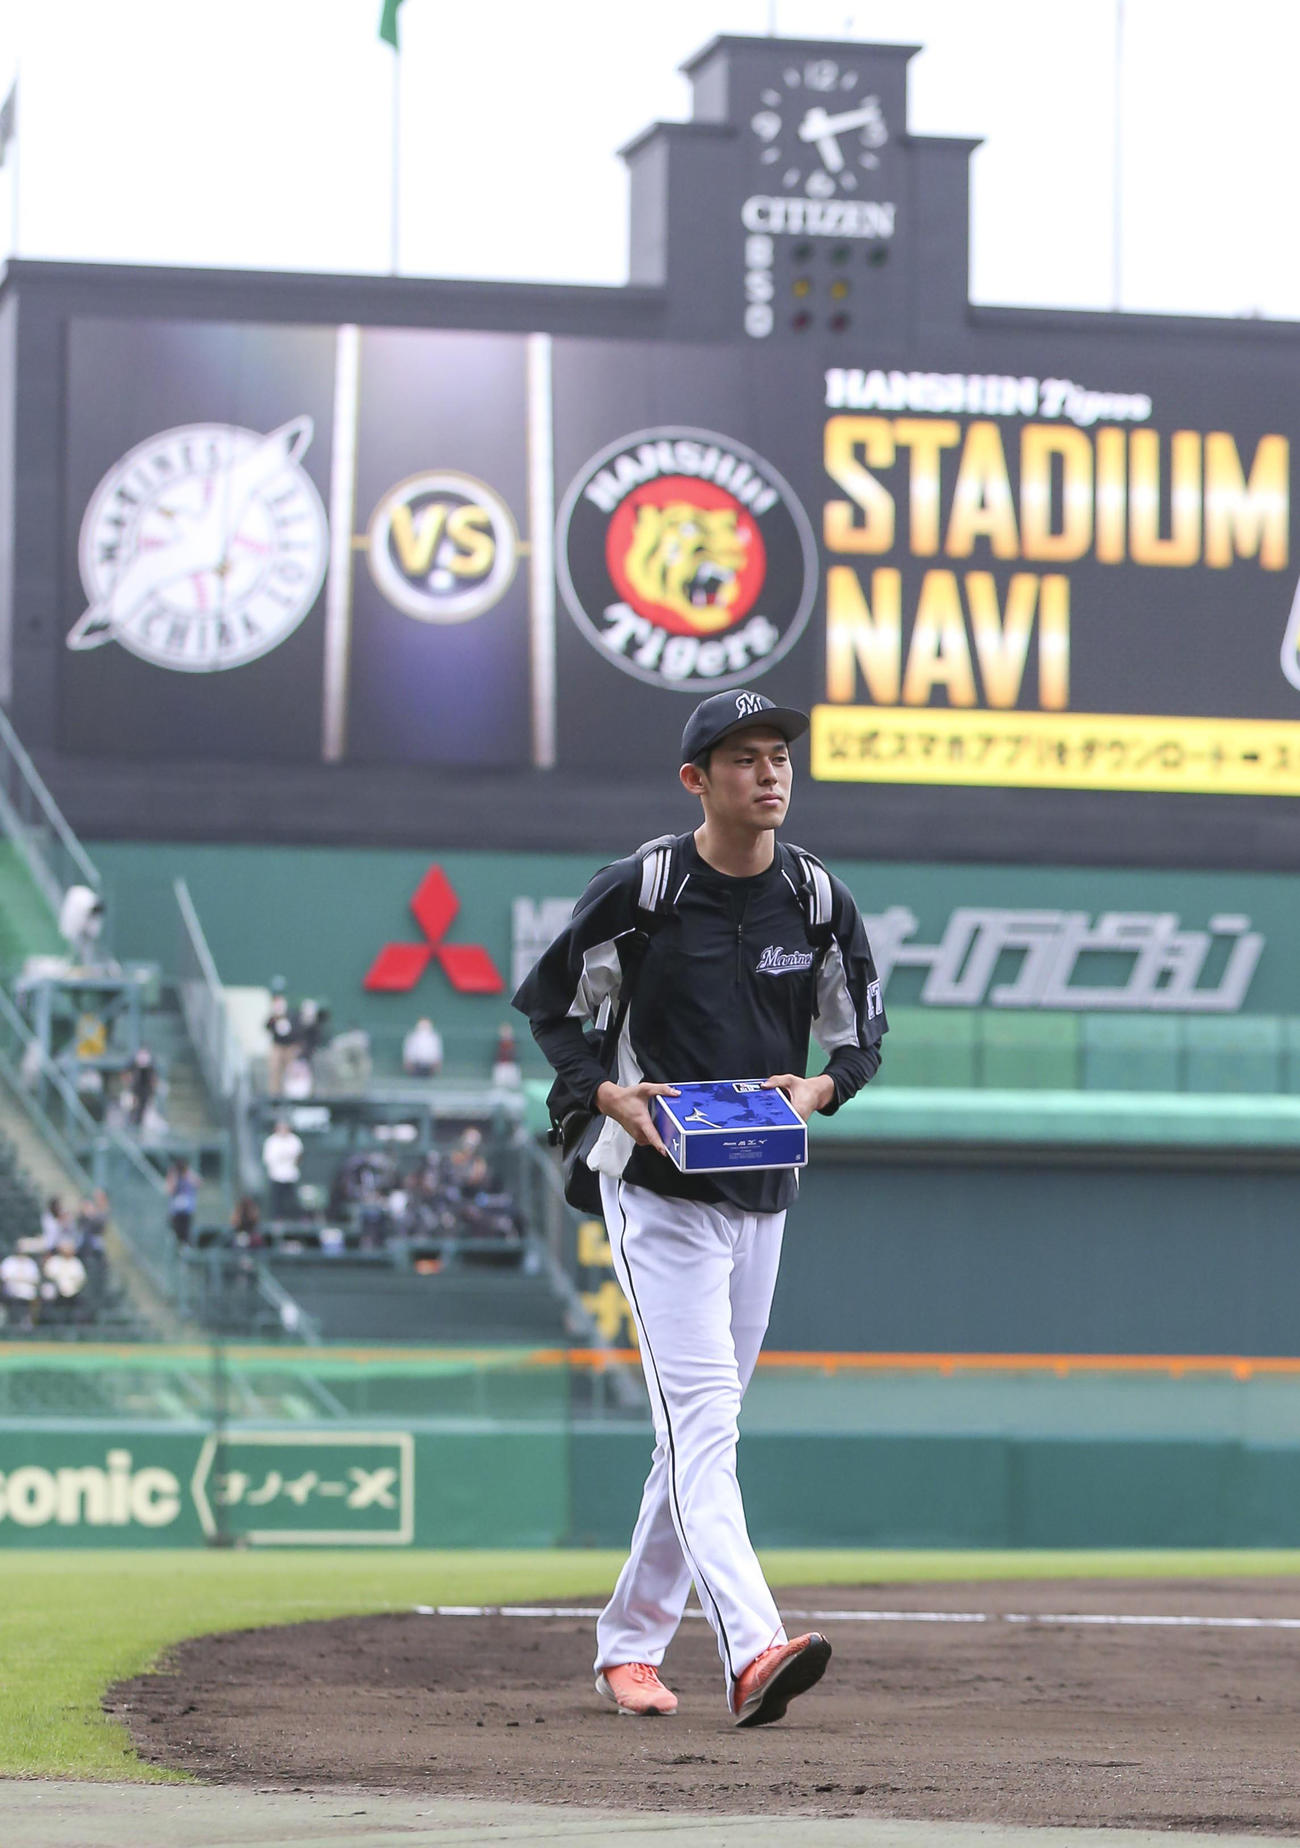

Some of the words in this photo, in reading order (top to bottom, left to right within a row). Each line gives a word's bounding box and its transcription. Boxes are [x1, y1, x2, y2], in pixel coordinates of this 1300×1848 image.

[741, 195, 895, 238] CITIZEN
[825, 368, 1038, 415] HANSHIN
[1038, 378, 1152, 425] Tigers
[583, 440, 778, 514] HANSHIN
[823, 414, 1289, 571] STADIUM
[389, 502, 497, 577] VS
[599, 601, 779, 680] Tigers
[826, 566, 1070, 710] NAVI
[0, 1449, 181, 1527] onic
